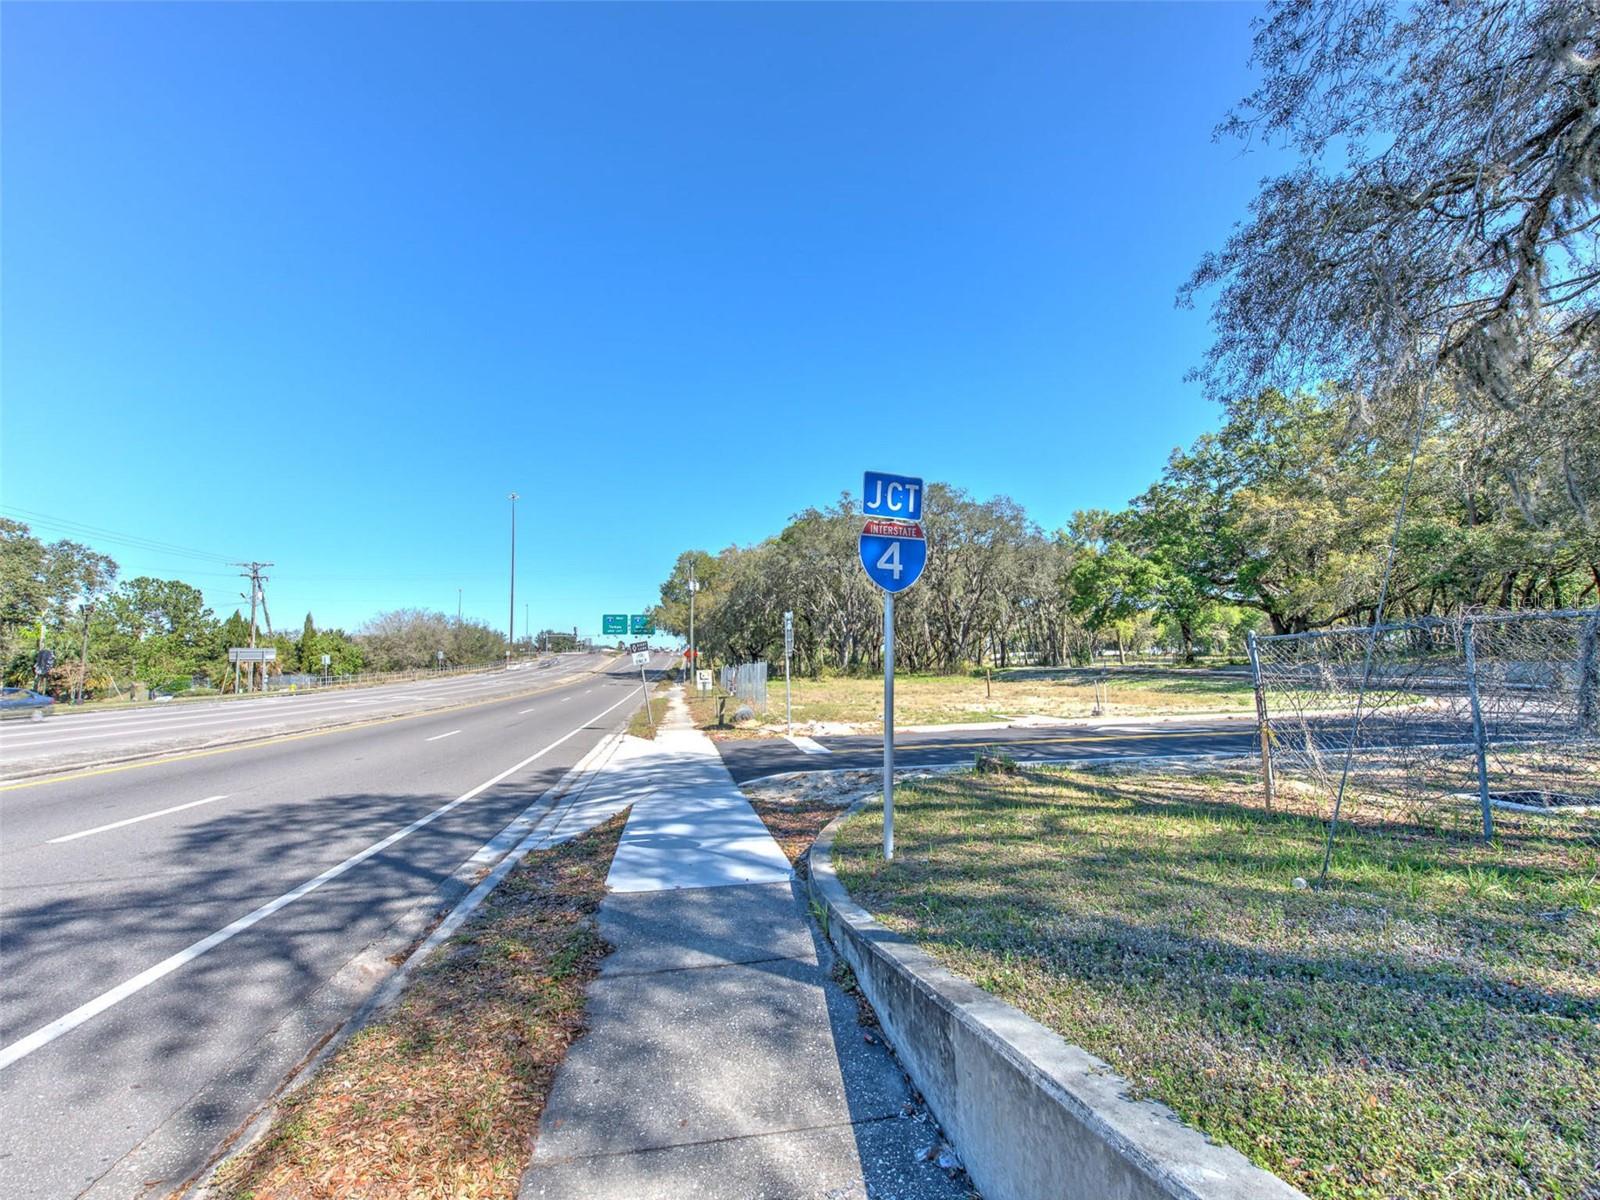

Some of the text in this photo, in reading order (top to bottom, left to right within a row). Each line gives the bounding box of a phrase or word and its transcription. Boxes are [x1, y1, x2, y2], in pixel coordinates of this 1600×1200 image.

[866, 480, 920, 513] JCT
[870, 524, 917, 537] INTERSTATE
[876, 541, 904, 580] 4
